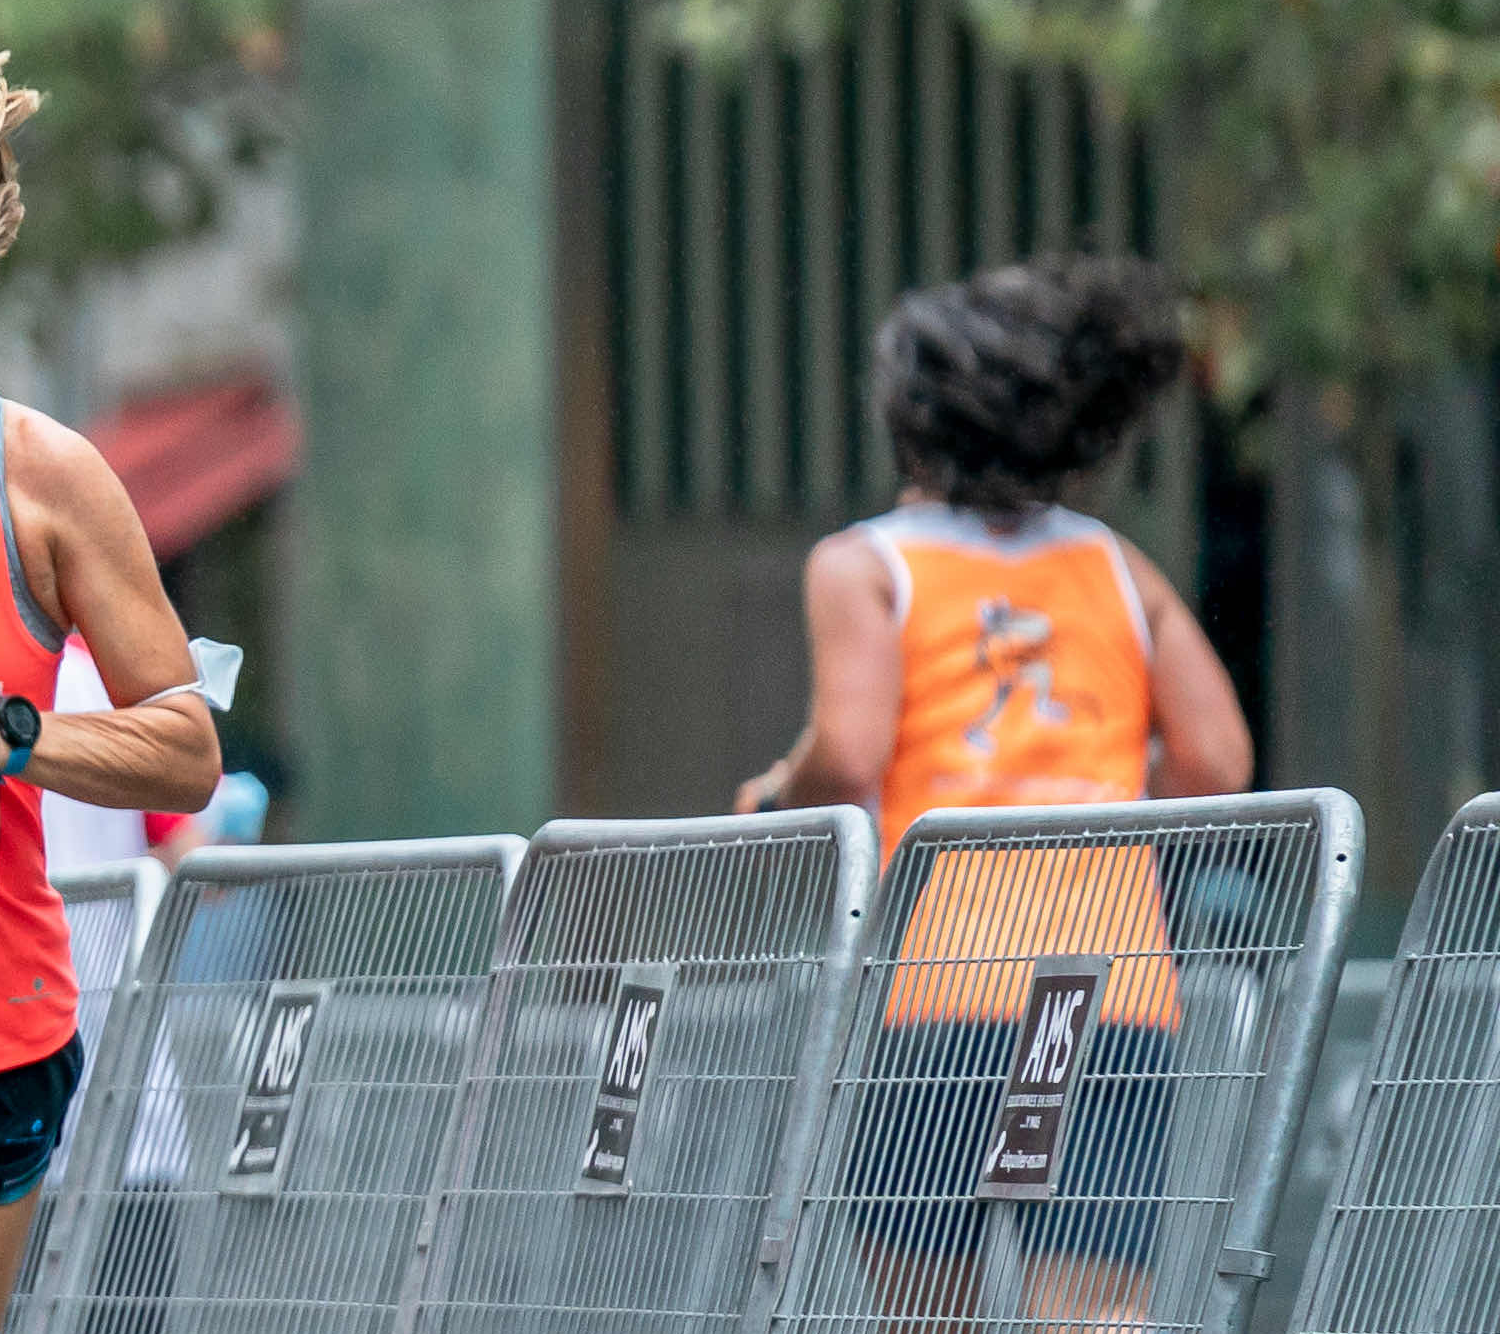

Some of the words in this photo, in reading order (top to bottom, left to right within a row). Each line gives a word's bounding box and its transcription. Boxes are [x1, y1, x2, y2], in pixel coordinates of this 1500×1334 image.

[257, 1005, 312, 1091] AMS
[607, 999, 656, 1090] AMS
[1021, 990, 1085, 1083] AMS
